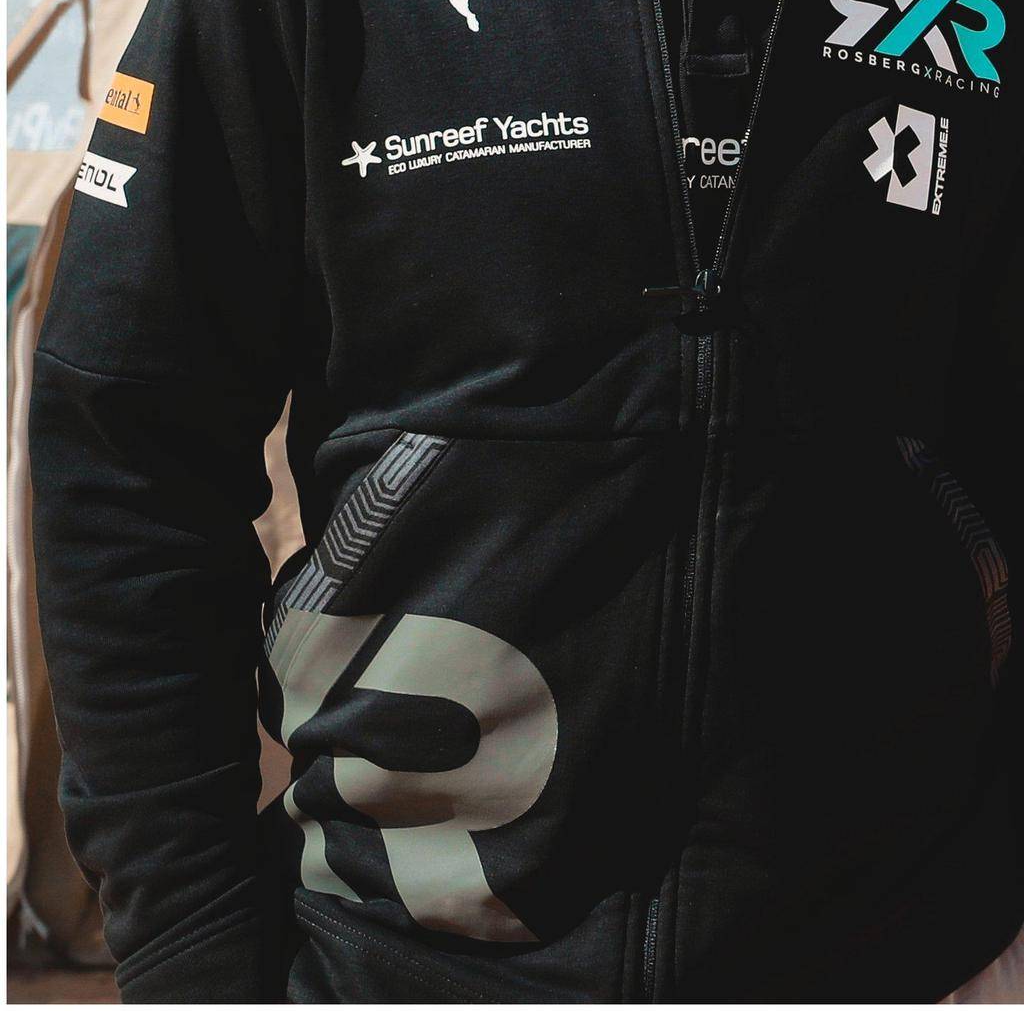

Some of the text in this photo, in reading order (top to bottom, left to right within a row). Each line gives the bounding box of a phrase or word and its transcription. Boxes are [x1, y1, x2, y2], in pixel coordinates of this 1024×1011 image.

[822, 45, 1000, 99] ROSBERGXRACING
[385, 111, 590, 161] Sunreef Yachts
[387, 138, 591, 176] ECO LUXURY CATAMARAN MANUFACTURER
[681, 136, 748, 166] ree
